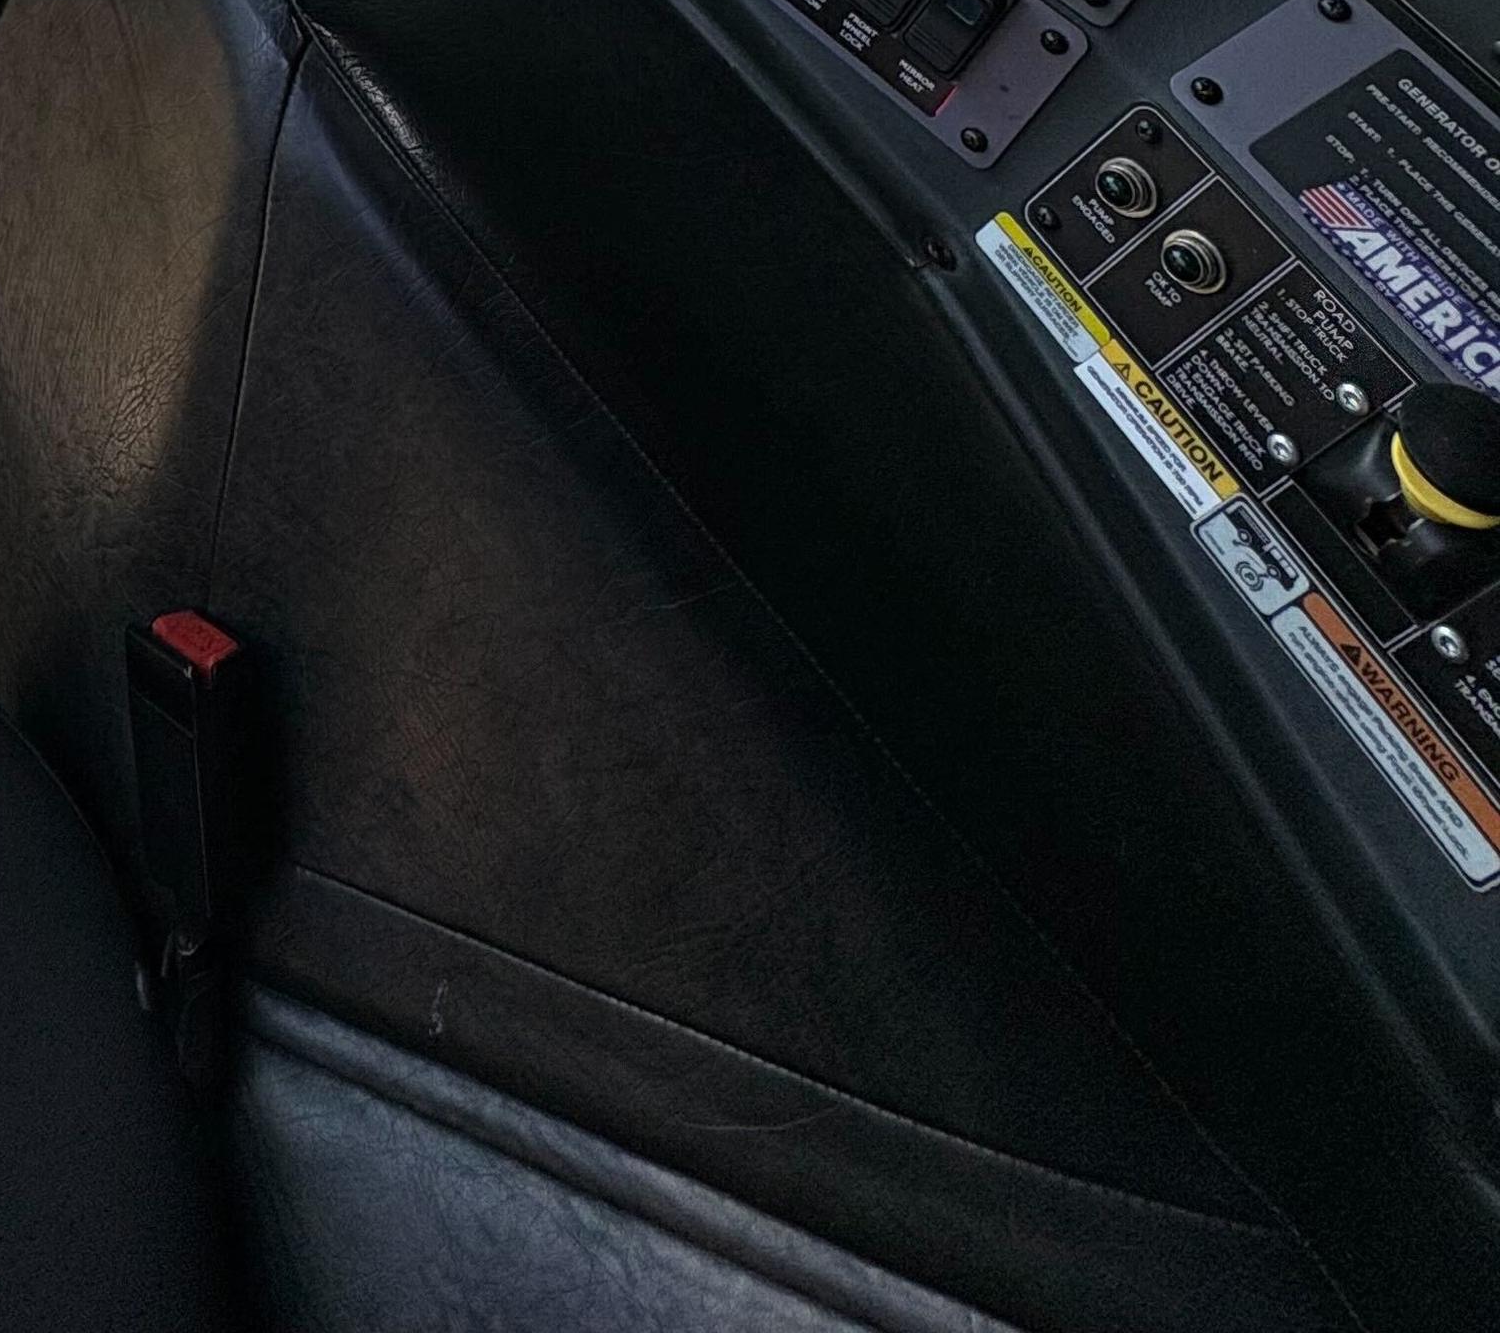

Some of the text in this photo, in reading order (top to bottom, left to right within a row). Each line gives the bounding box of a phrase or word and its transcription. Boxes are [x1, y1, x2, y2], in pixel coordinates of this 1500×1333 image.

[839, 29, 864, 52] LOCK
[842, 19, 872, 47] WHEEL
[847, 12, 879, 38] FRONT
[898, 58, 936, 92] MIRROR
[898, 70, 924, 93] HEAT
[1397, 78, 1488, 159] GENERATOR
[1088, 198, 1115, 226] PUMP
[1398, 158, 1434, 193] PLACE
[1432, 189, 1456, 213] THE
[1071, 194, 1116, 245] ENGAGED
[1358, 184, 1395, 217] PLACE
[1393, 216, 1416, 239] THE
[1413, 237, 1479, 301] GENERATOR
[1372, 178, 1489, 290] TURN OFF ALL DEVICES
[1032, 256, 1082, 313] CAUTION
[1151, 271, 1182, 304] OK TO
[1344, 191, 1383, 227] MADE
[1386, 229, 1420, 262] WITH
[1421, 265, 1466, 305] PRIDE
[1465, 308, 1485, 326] IN
[1144, 278, 1174, 308] PUMP
[1276, 287, 1349, 364] 1. STOP TRUCK
[1312, 288, 1357, 334] ROAD
[1373, 280, 1396, 300] BY
[1396, 302, 1451, 354] PEOPLE
[1250, 306, 1336, 402] TRANSMISSION TO
[1257, 300, 1329, 377] 2. SHIFT TRUCK
[1312, 310, 1355, 351] PUMP
[1209, 358, 1275, 433] THROW LEVER
[1222, 326, 1296, 408] 3. SET PARKING
[1126, 413, 1166, 462] OPERATION
[1135, 381, 1224, 483] CAUTION
[1174, 366, 1241, 445] TRANSMISSION
[1237, 442, 1264, 471] INTO
[1190, 372, 1267, 458] ENGAGE TRUCK
[1146, 424, 1171, 453] SPEED
[1169, 453, 1187, 473] FOR
[1299, 626, 1340, 673] ALWAYS
[1436, 798, 1464, 829] AND
[1359, 662, 1461, 783] WARNING
